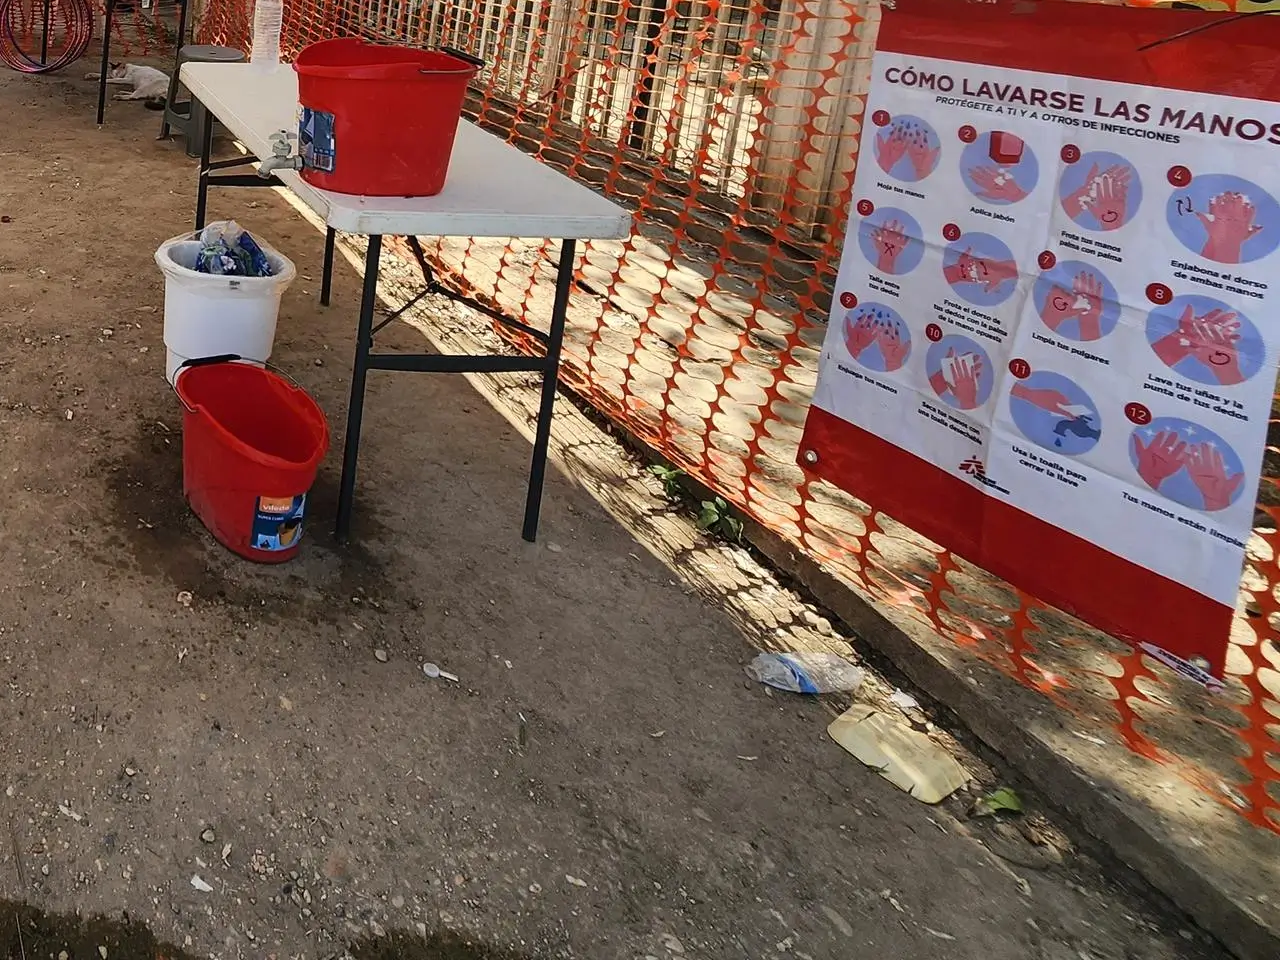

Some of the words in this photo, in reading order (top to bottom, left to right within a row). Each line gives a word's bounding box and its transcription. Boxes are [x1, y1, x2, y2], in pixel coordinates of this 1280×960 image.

[884, 66, 955, 92] CÓMO
[963, 78, 1085, 113] LAVARSE
[1094, 97, 1151, 124] LAS
[935, 95, 993, 112] PROTÉGETE
[995, 105, 1004, 114] A
[1007, 106, 1017, 116] TI
[1020, 109, 1028, 118] Y
[1029, 111, 1038, 120] A
[1041, 113, 1080, 127] OTROS
[1082, 120, 1098, 130] DE
[1100, 122, 1181, 144] INFECCIONES
[964, 129, 971, 139] 2
[1066, 149, 1074, 159] 3
[1173, 171, 1182, 181] 4
[877, 182, 892, 191] Moja
[894, 186, 904, 194] tus
[905, 189, 925, 199] manos
[862, 203, 869, 211] 5
[970, 206, 992, 217] Aplica
[993, 212, 1015, 223] jabón
[948, 228, 955, 236] 6
[1061, 230, 1079, 241] Frota
[1081, 236, 1093, 245] tus
[1094, 240, 1121, 253] manos
[1044, 255, 1050, 264] 7
[1059, 240, 1080, 251] palma
[1081, 246, 1096, 255] con
[1097, 251, 1122, 263] palma
[1170, 259, 1219, 278] Enjabona
[1221, 273, 1231, 281] el
[1234, 276, 1268, 290] dorso
[880, 287, 899, 298] dedos
[884, 280, 900, 290] entre
[1174, 271, 1187, 279] de
[1190, 276, 1224, 289] ambas
[1226, 285, 1264, 299] manos
[845, 296, 852, 304] 9
[1154, 289, 1164, 299] 8
[933, 303, 943, 312] tus
[944, 308, 965, 320] dedos
[966, 317, 980, 326] con
[943, 299, 962, 310] Frota
[971, 310, 992, 321] dorso
[992, 317, 1001, 325] de
[929, 327, 940, 338] 10
[955, 320, 975, 332] mano
[975, 329, 1002, 343] opuesta
[1057, 341, 1069, 351] tus
[1071, 347, 1110, 366] pulgares
[1015, 364, 1026, 375] 11
[875, 381, 898, 394] manos
[1148, 373, 1173, 386] Lava
[1175, 382, 1192, 393] tus
[1194, 388, 1221, 402] uñas
[1223, 397, 1230, 405] y
[1233, 400, 1244, 409] la
[1143, 382, 1174, 397] punta
[1177, 393, 1190, 402] de
[1193, 398, 1210, 409] tus
[1213, 405, 1249, 422] dedos
[1130, 407, 1146, 421] 12
[1012, 445, 1028, 457] Usa
[1029, 452, 1037, 461] la
[1039, 457, 1064, 472] toalla
[1066, 469, 1087, 482] para
[1019, 458, 1045, 473] cerrar
[1046, 469, 1055, 478] la
[1057, 473, 1079, 488] llave
[1122, 491, 1139, 504] Tus
[1141, 500, 1175, 519] manos
[1177, 515, 1207, 533] están
